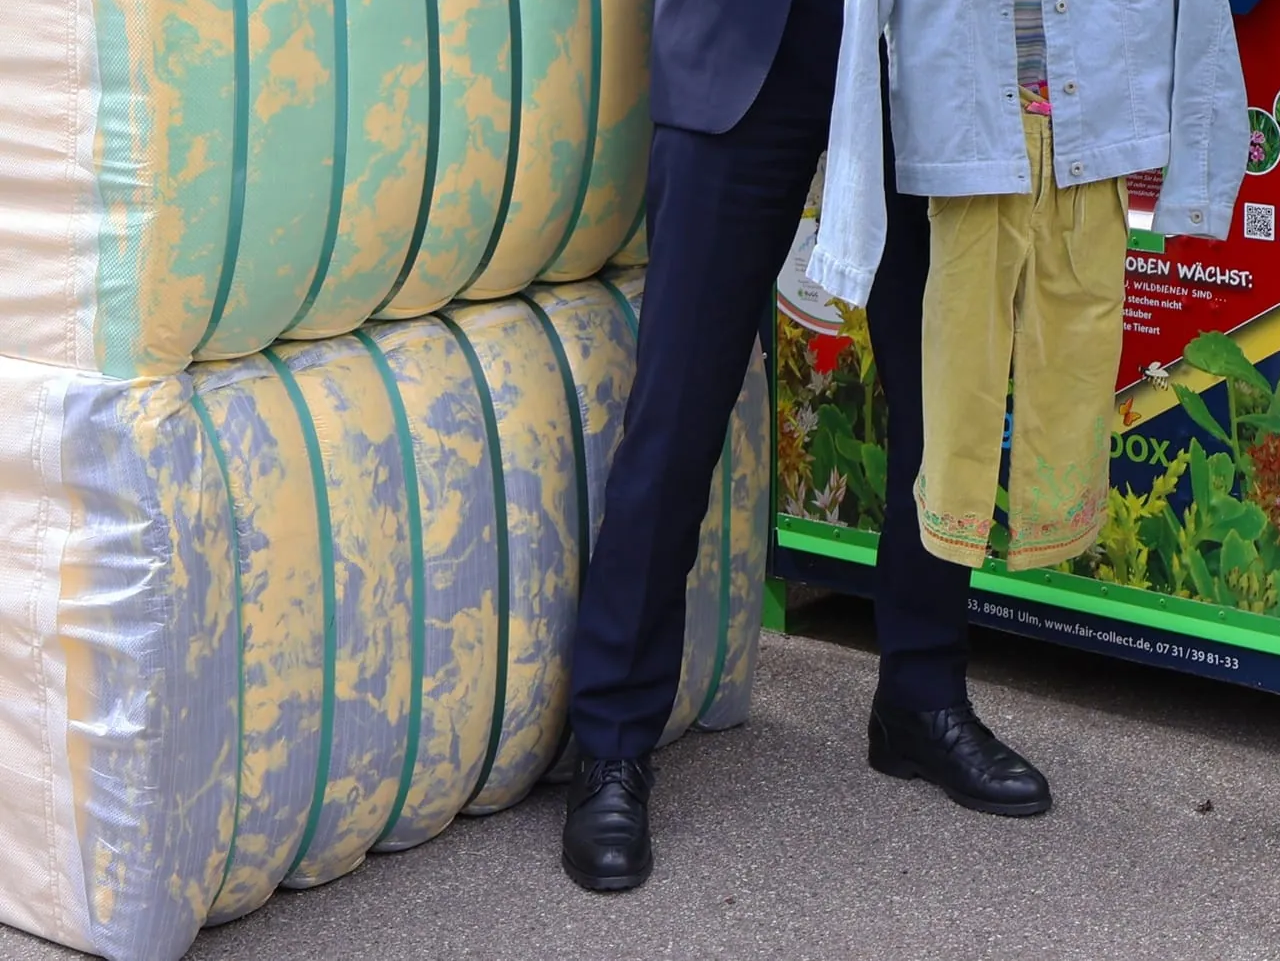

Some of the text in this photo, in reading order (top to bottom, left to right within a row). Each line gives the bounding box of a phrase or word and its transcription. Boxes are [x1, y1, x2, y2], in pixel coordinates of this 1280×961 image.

[1125, 256, 1253, 288] OBEN WÄCHST:
[1133, 281, 1188, 296] WILDBIENEN
[1191, 289, 1213, 300] SIND
[1127, 295, 1182, 311] stechen nicht
[1133, 323, 1160, 335] Tierart
[983, 602, 1014, 620] 89081
[1017, 610, 1042, 629] Ulm,
[1044, 618, 1153, 653] www.fair-collect.de,
